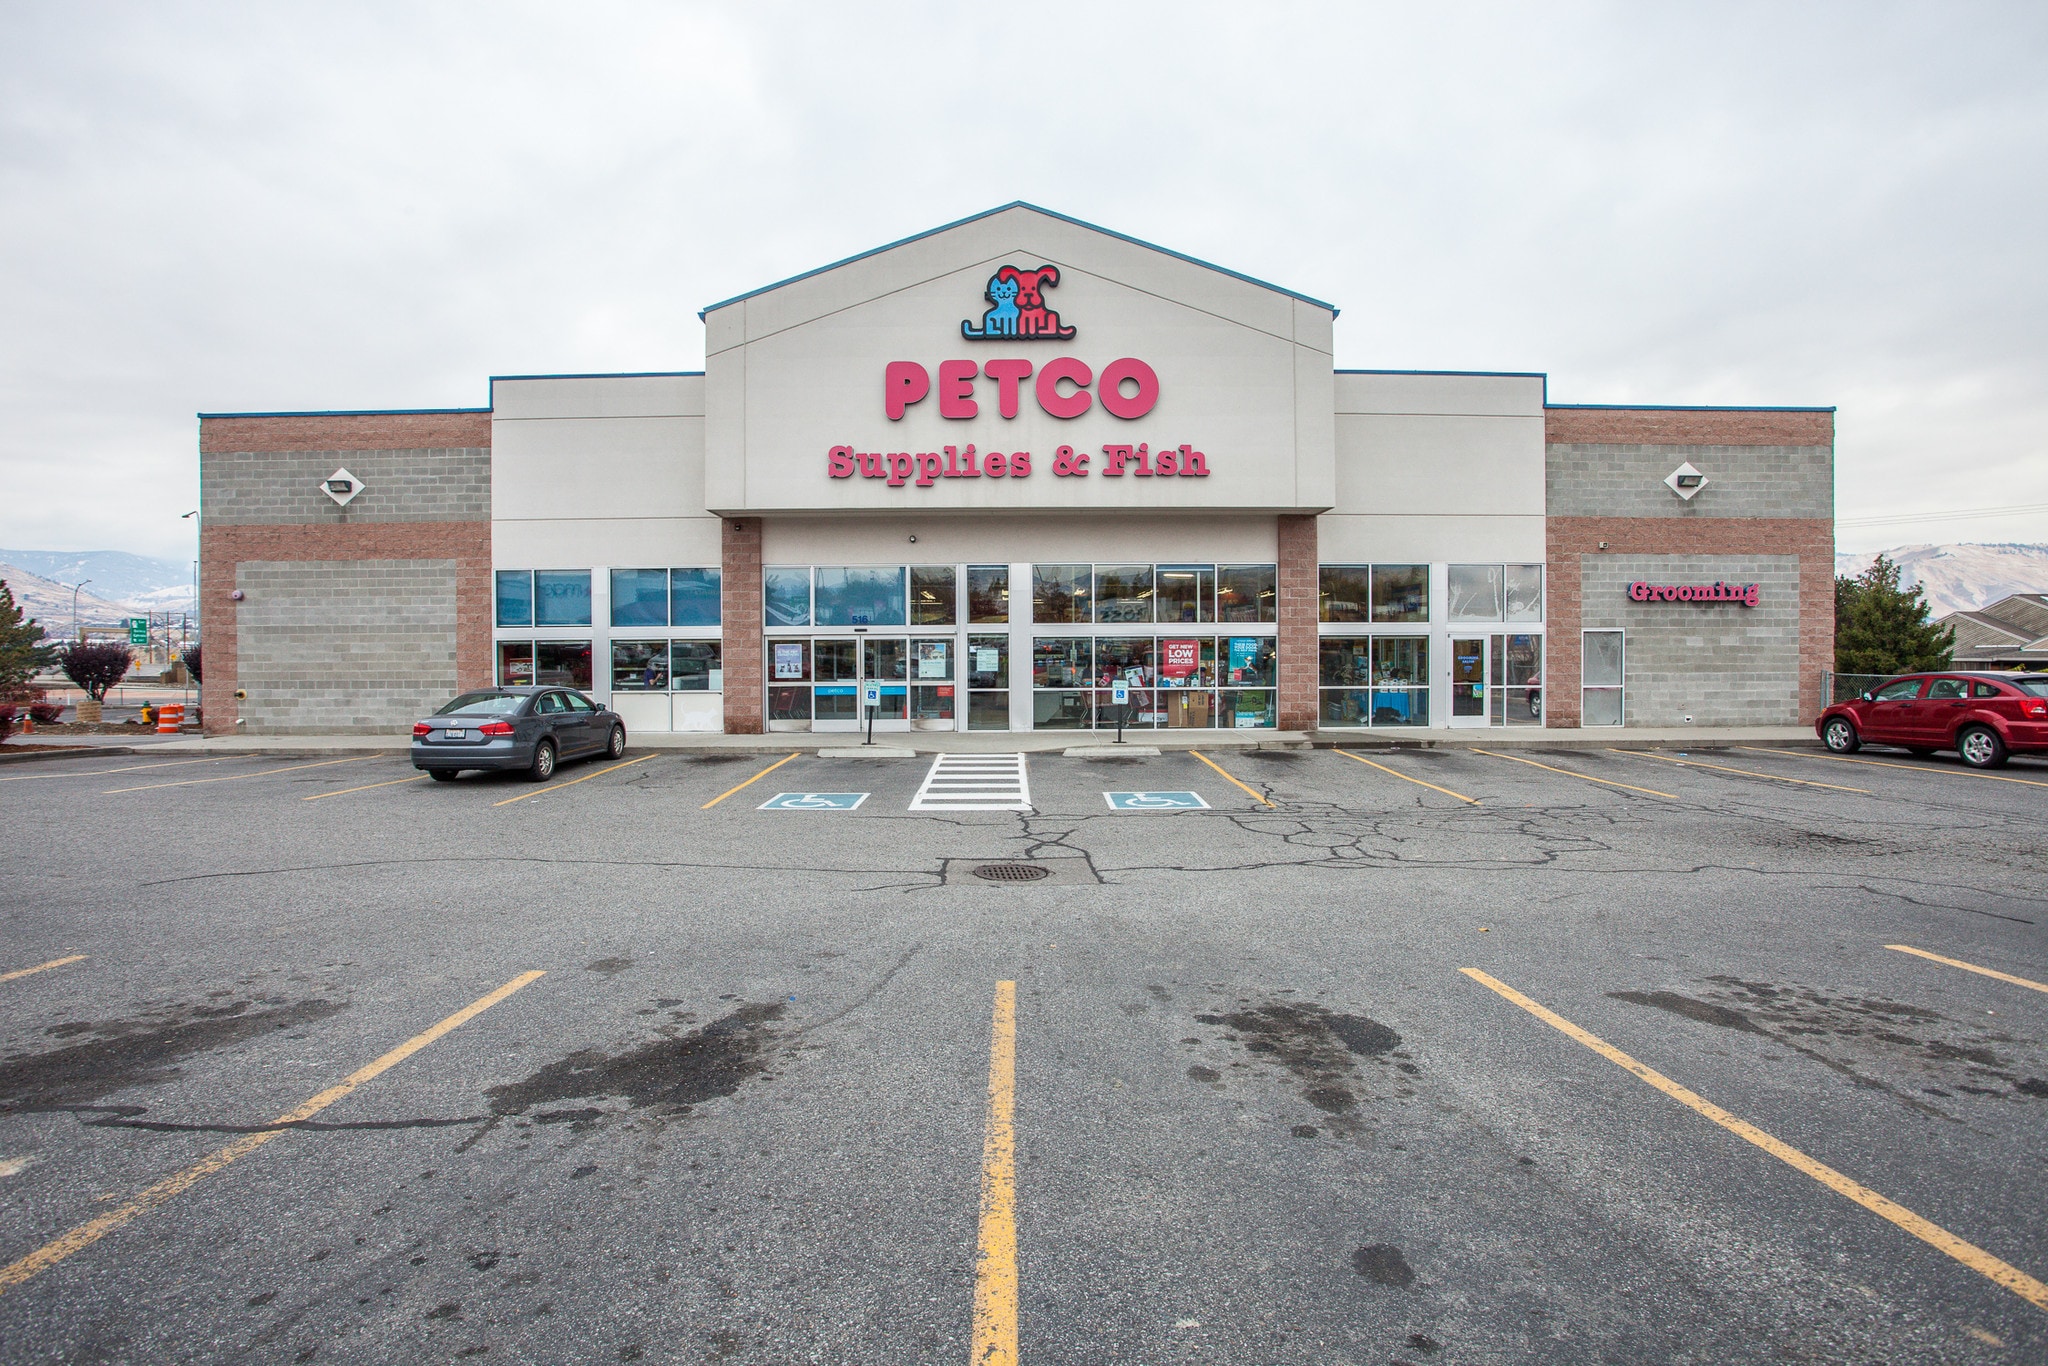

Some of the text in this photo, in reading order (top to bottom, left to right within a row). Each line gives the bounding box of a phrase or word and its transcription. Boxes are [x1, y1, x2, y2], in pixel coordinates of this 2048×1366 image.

[885, 356, 1160, 420] PETCO
[827, 442, 1211, 488] Supplies & Fish
[1628, 580, 1760, 607] Grooming
[851, 615, 869, 625] 516
[1168, 649, 1194, 658] LOW
